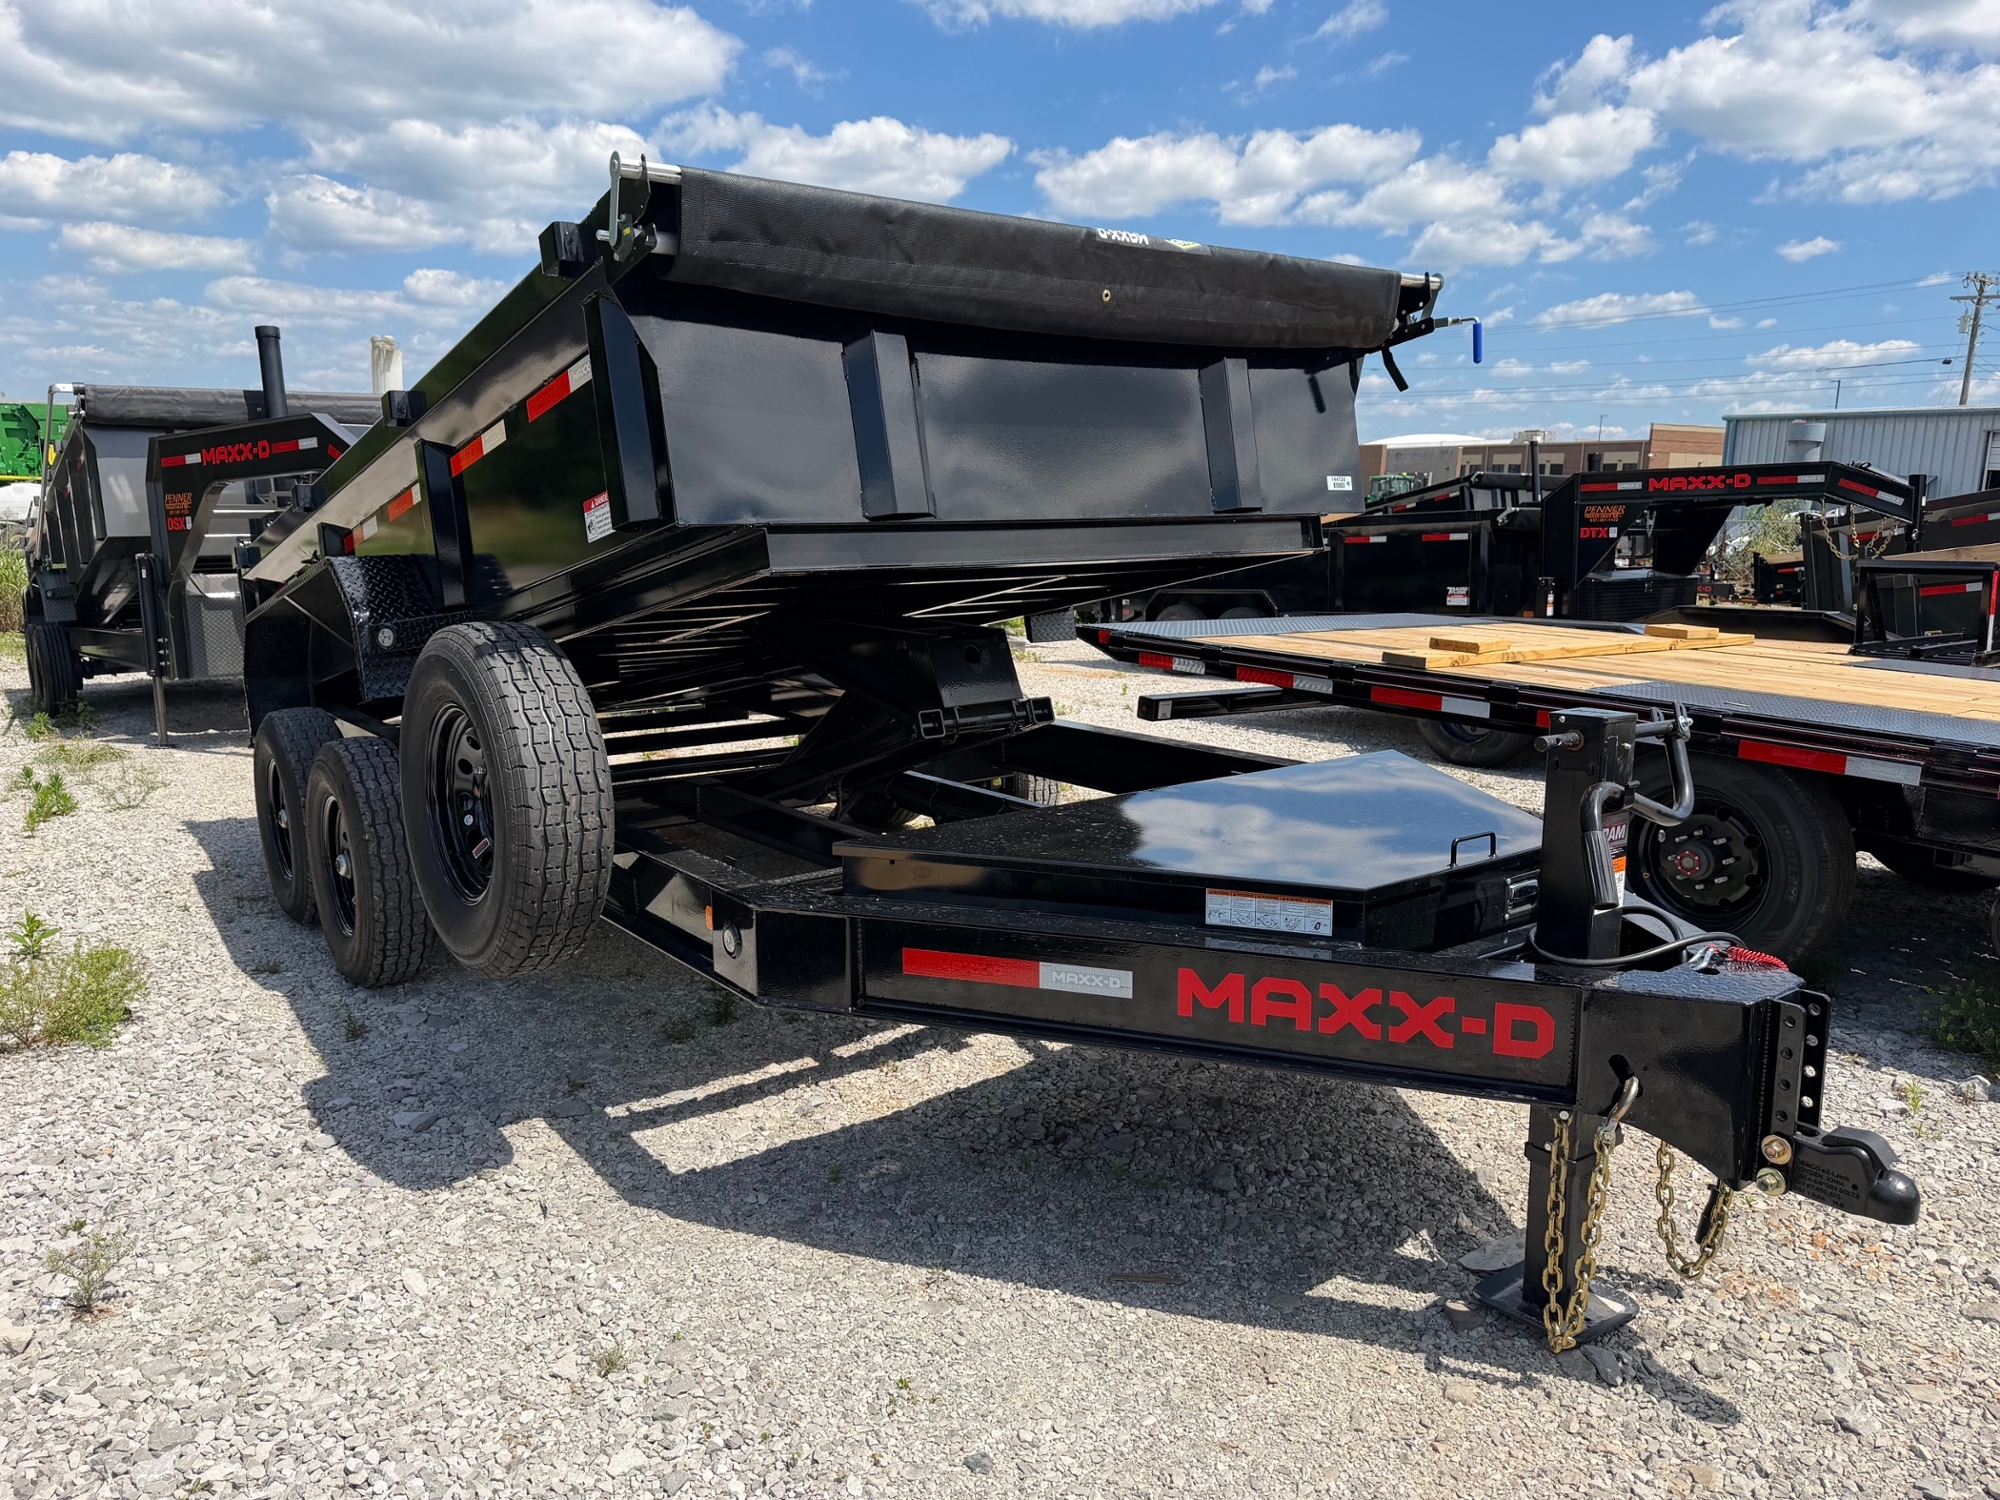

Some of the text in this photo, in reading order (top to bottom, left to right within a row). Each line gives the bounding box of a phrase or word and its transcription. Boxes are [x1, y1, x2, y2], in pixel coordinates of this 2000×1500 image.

[201, 440, 270, 466] MAXX-D
[1648, 474, 1751, 492] MAXX-D
[164, 492, 192, 504] PENNER
[1584, 505, 1626, 514] PENNER
[167, 516, 186, 530] DSX
[1580, 527, 1608, 538] DTX
[1052, 970, 1121, 989] MAXX-D
[1176, 966, 1555, 1060] MAXX-D
[1826, 1177, 1845, 1187] IOWA
